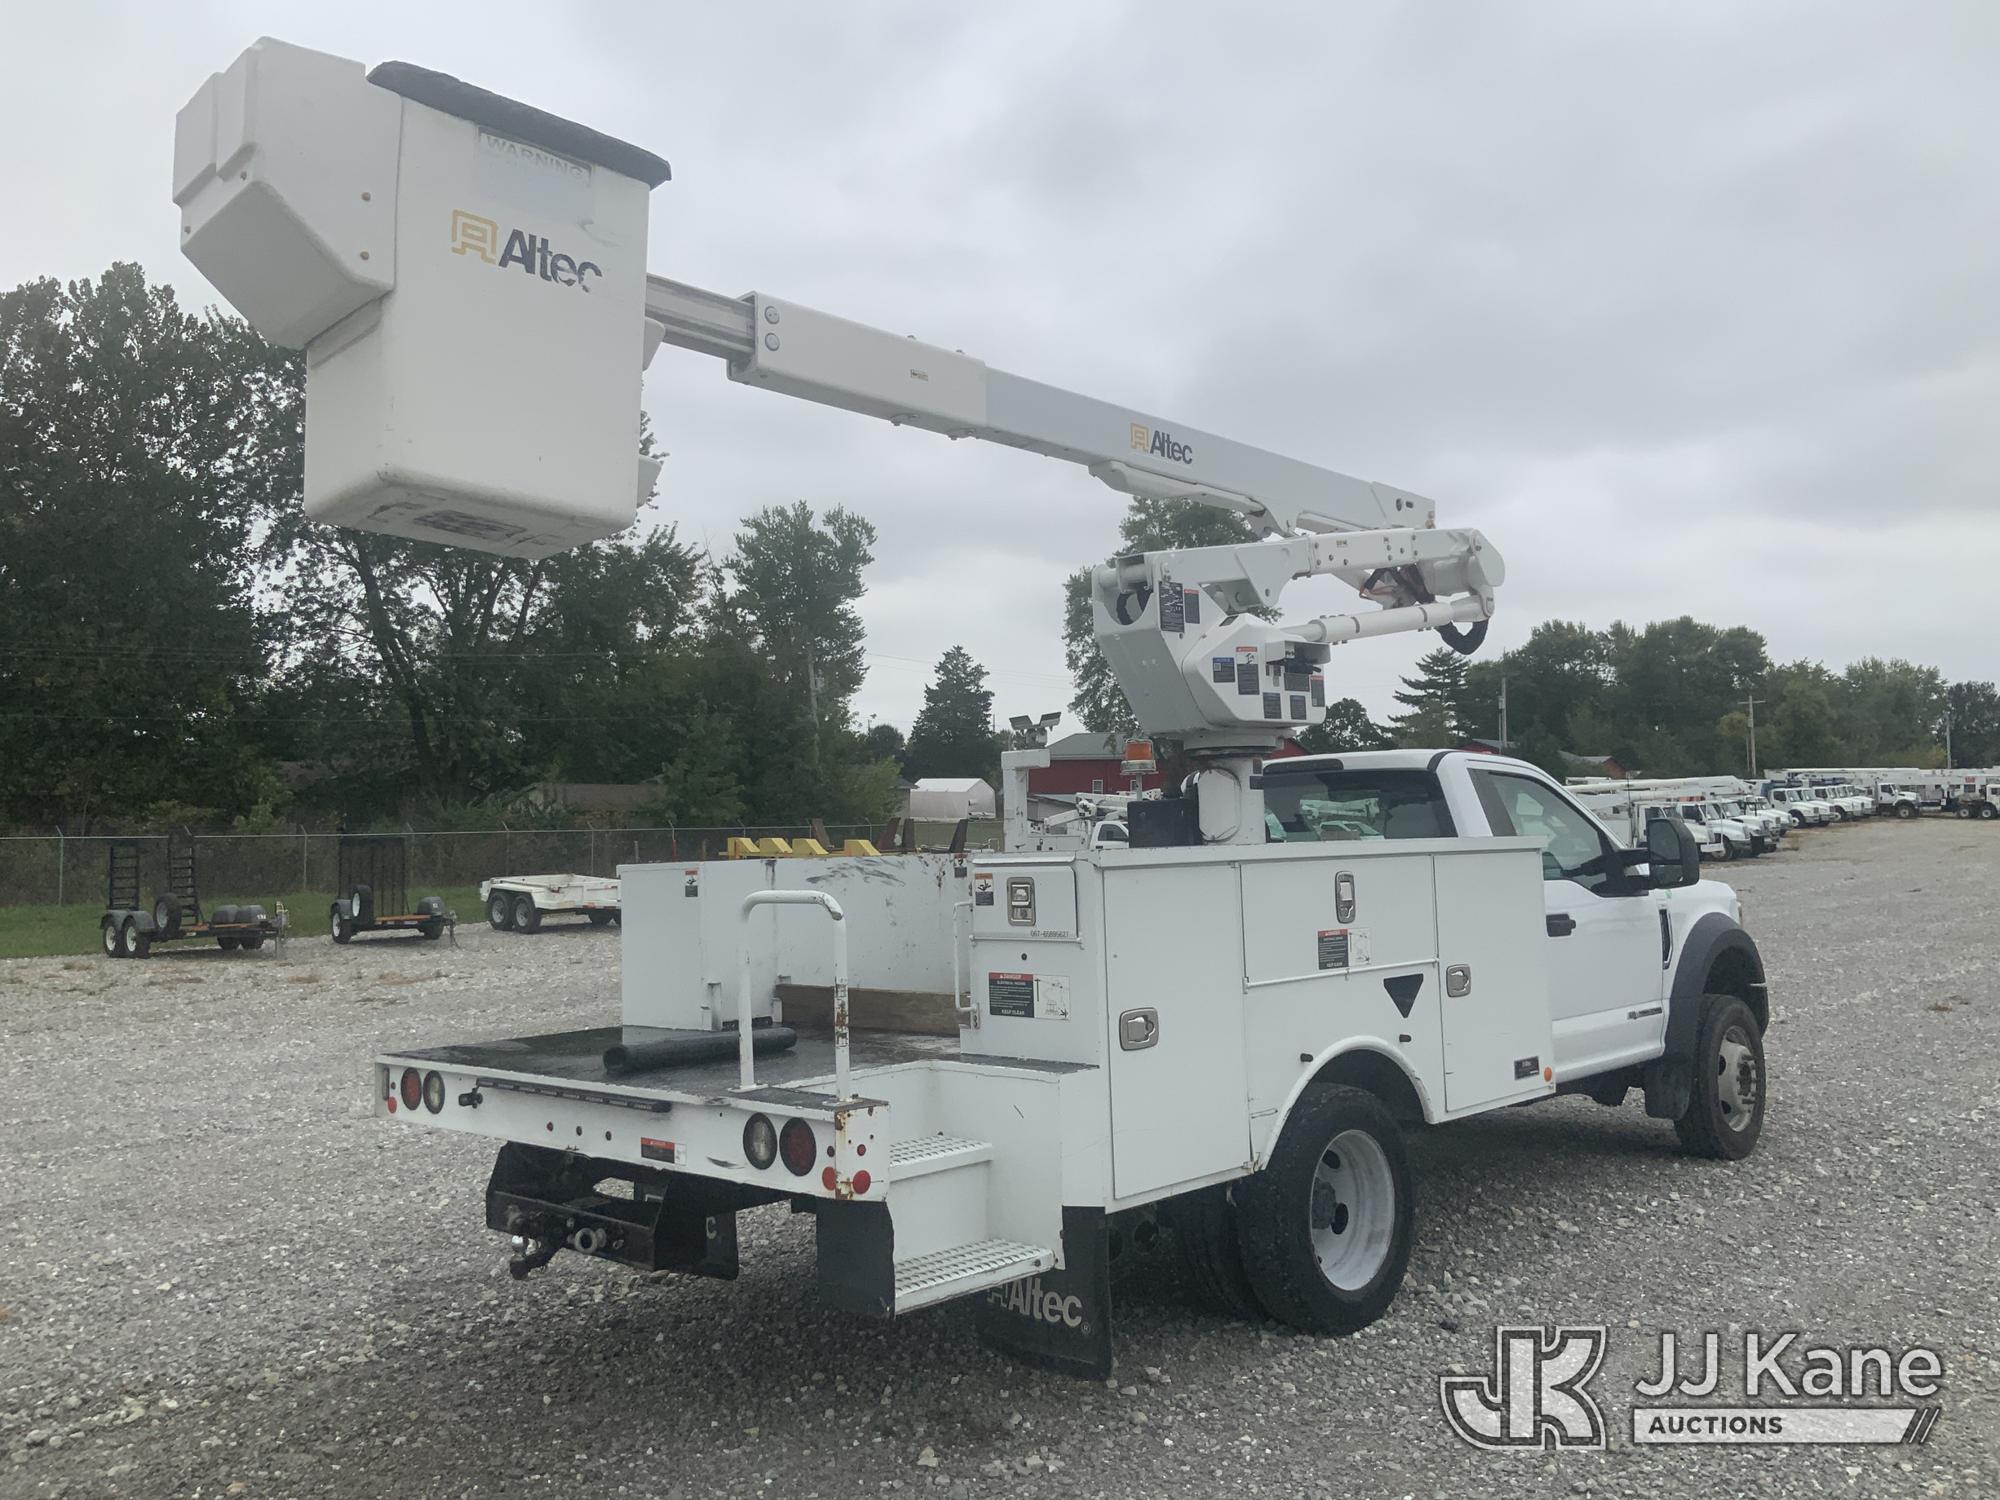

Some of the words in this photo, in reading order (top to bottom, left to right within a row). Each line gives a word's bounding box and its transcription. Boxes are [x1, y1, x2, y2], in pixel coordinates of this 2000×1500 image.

[486, 134, 584, 177] WARNING
[498, 228, 603, 293] Altec
[1149, 430, 1193, 465] Altec
[1008, 1275, 1082, 1327] Altec
